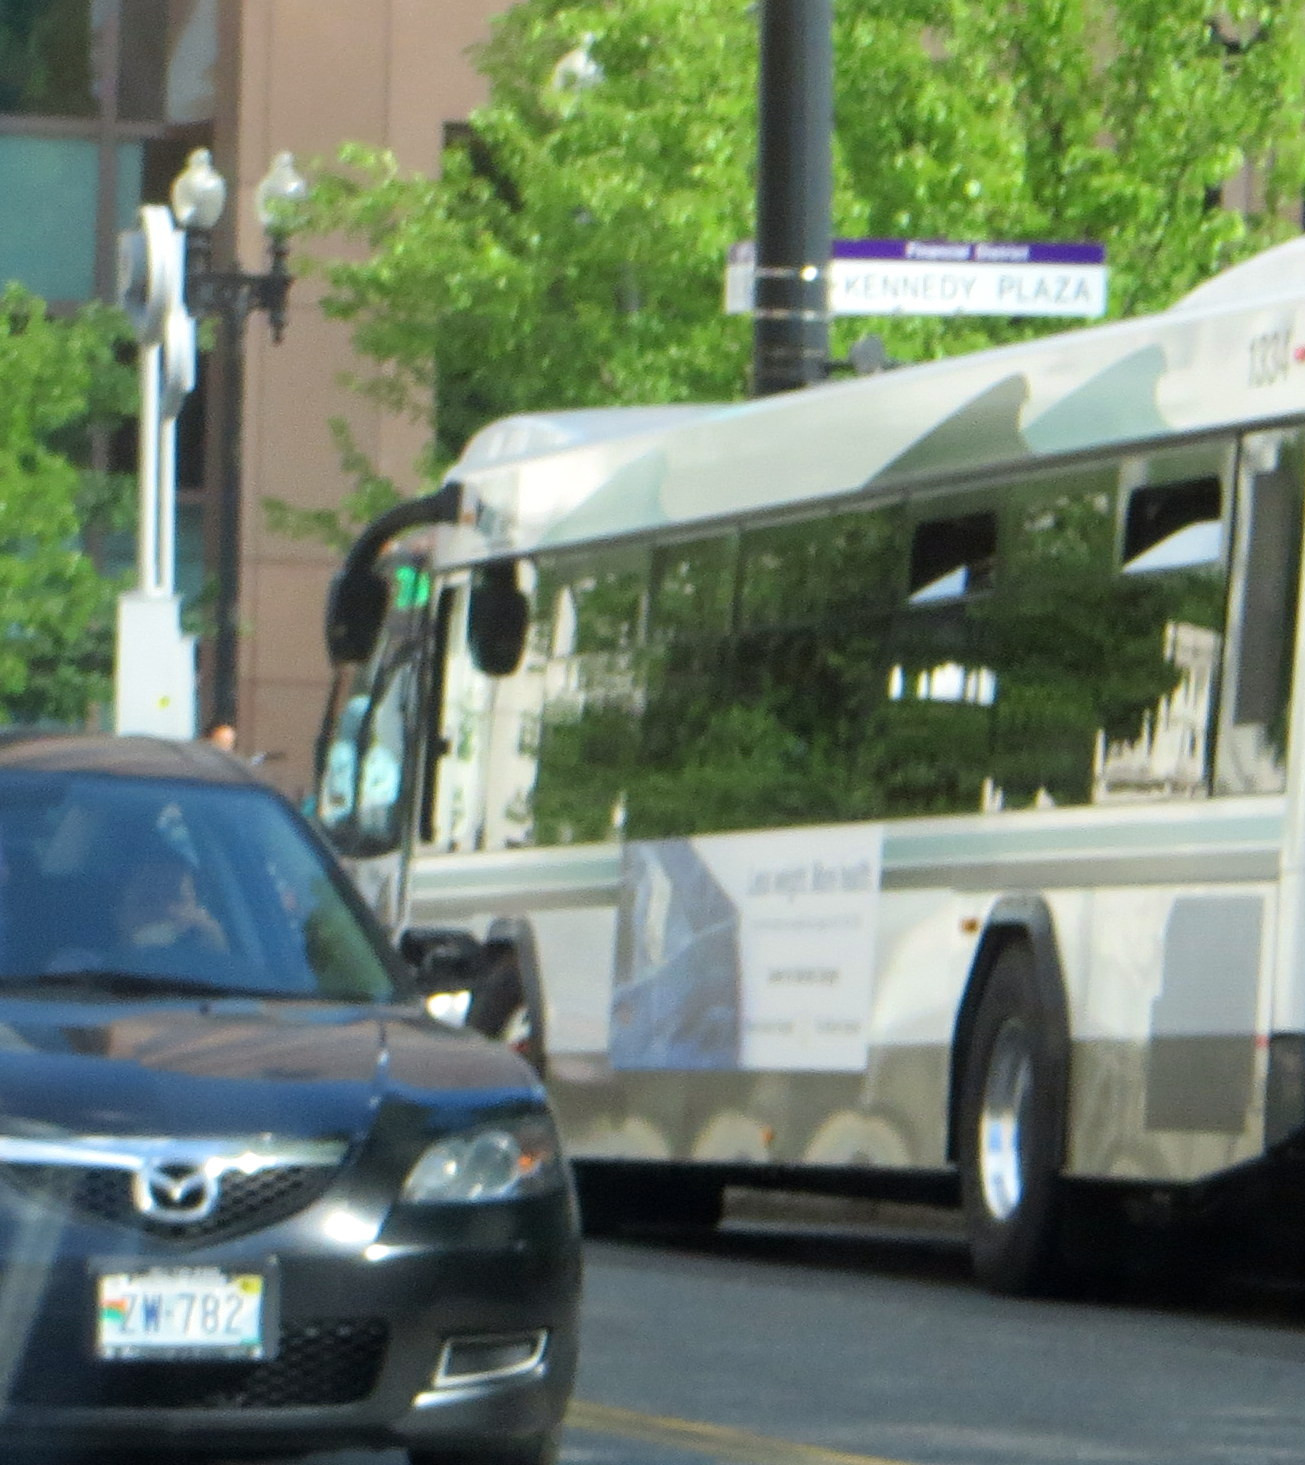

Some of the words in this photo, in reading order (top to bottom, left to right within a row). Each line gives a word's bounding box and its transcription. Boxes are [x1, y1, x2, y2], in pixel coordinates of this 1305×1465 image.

[845, 273, 977, 301] KENNEDY
[999, 275, 1091, 304] PLAZA
[1248, 328, 1294, 387] 1334
